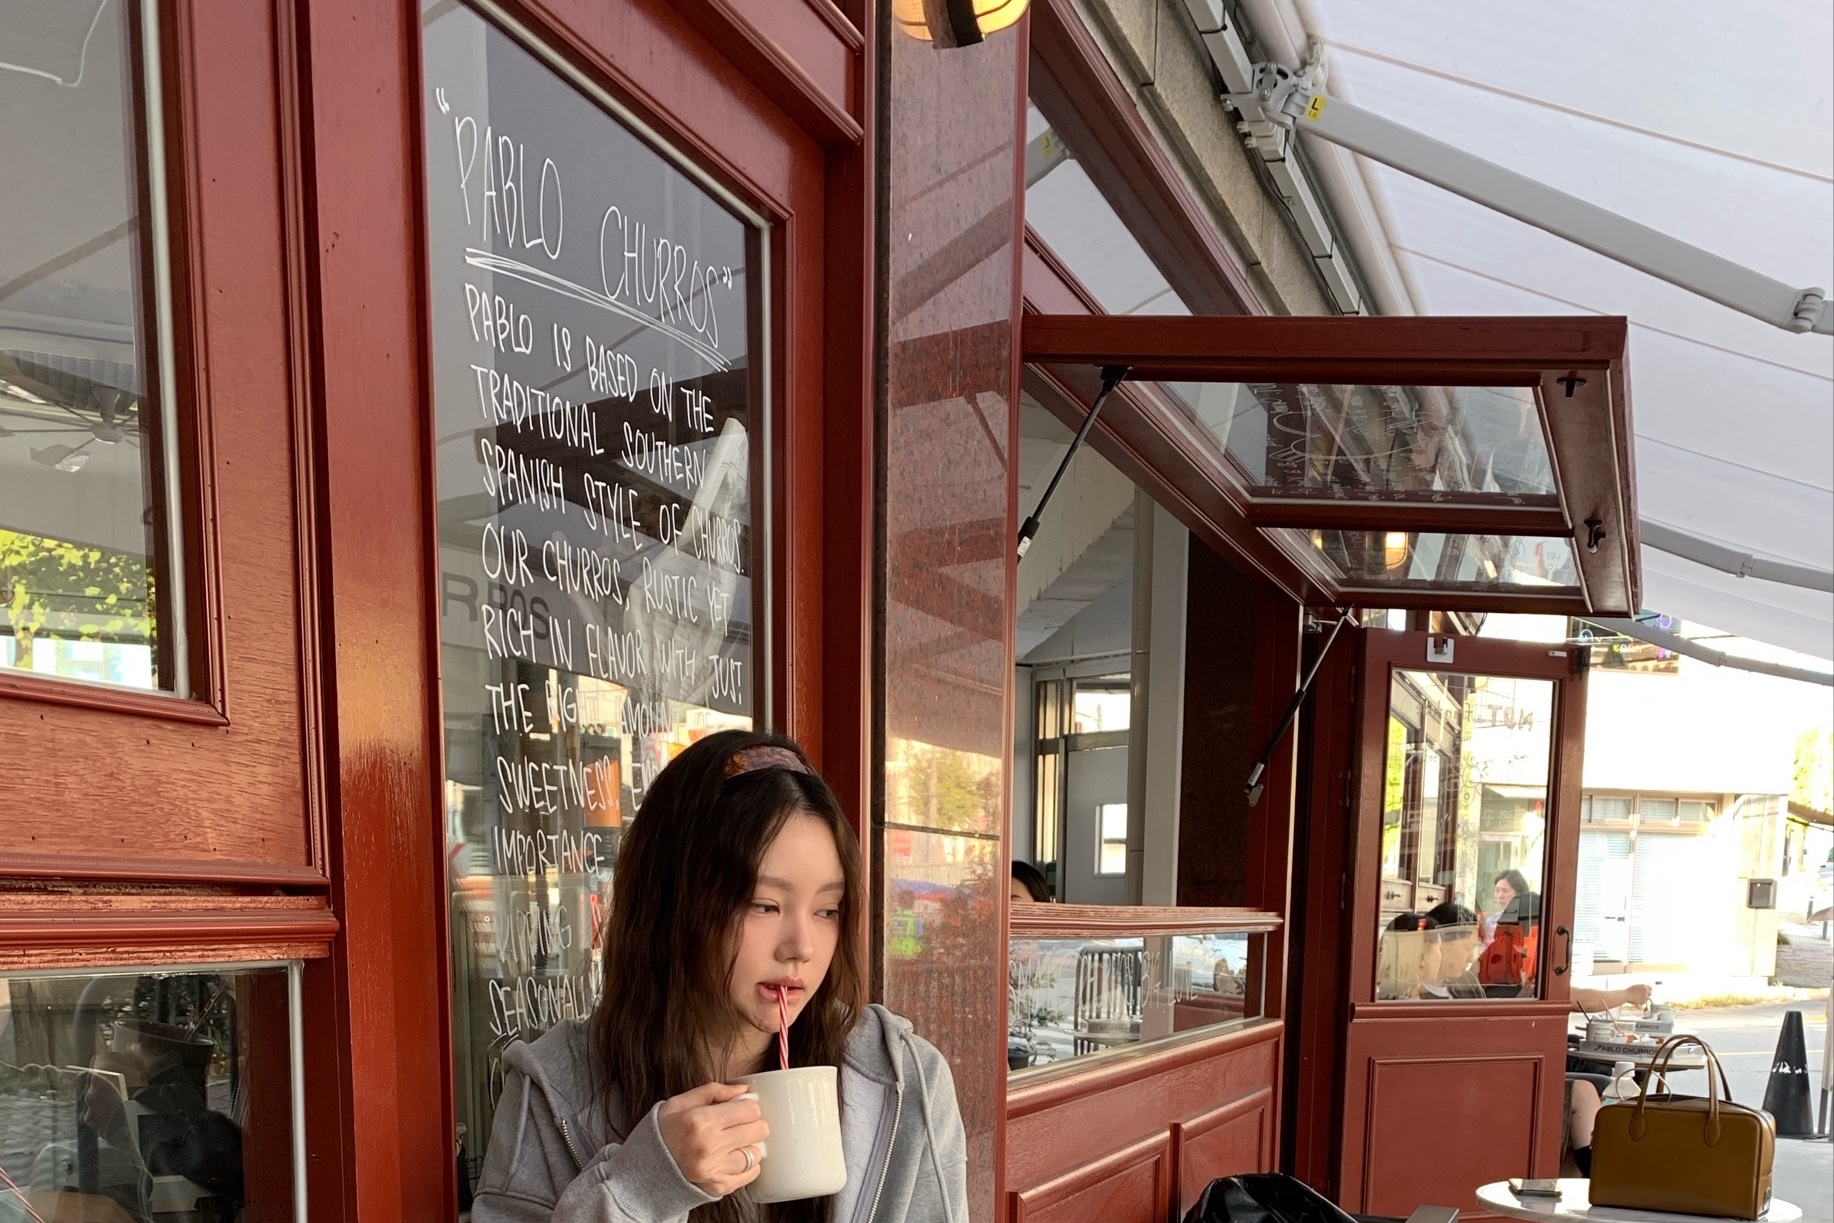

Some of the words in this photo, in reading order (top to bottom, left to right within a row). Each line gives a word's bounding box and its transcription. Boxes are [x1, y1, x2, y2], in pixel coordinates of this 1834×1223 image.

[1310, 97, 1320, 111] L
[464, 282, 534, 355] PABLO
[552, 323, 572, 373] IS
[585, 334, 639, 403] BASED
[649, 367, 673, 423] ON
[680, 386, 715, 434] THE
[470, 363, 605, 458] TRADITIONAL
[621, 421, 707, 491] SOUTHERN
[480, 437, 566, 514] SPANISH
[582, 472, 643, 552] STYLE
[659, 502, 683, 556] OF
[691, 504, 745, 574] CHURROS.
[481, 521, 534, 588] OUR
[542, 539, 631, 612] CHURROS,
[642, 555, 698, 624] RUSTIC
[706, 580, 730, 637] YET
[481, 604, 539, 663] RICH
[549, 615, 573, 672] IN
[586, 622, 648, 681] FLAVOR
[655, 635, 696, 685] WITH
[708, 654, 743, 706] JUST
[485, 682, 535, 736] THE
[494, 825, 605, 880] IMPORTANCE
[1594, 1044, 1622, 1053] PABLO
